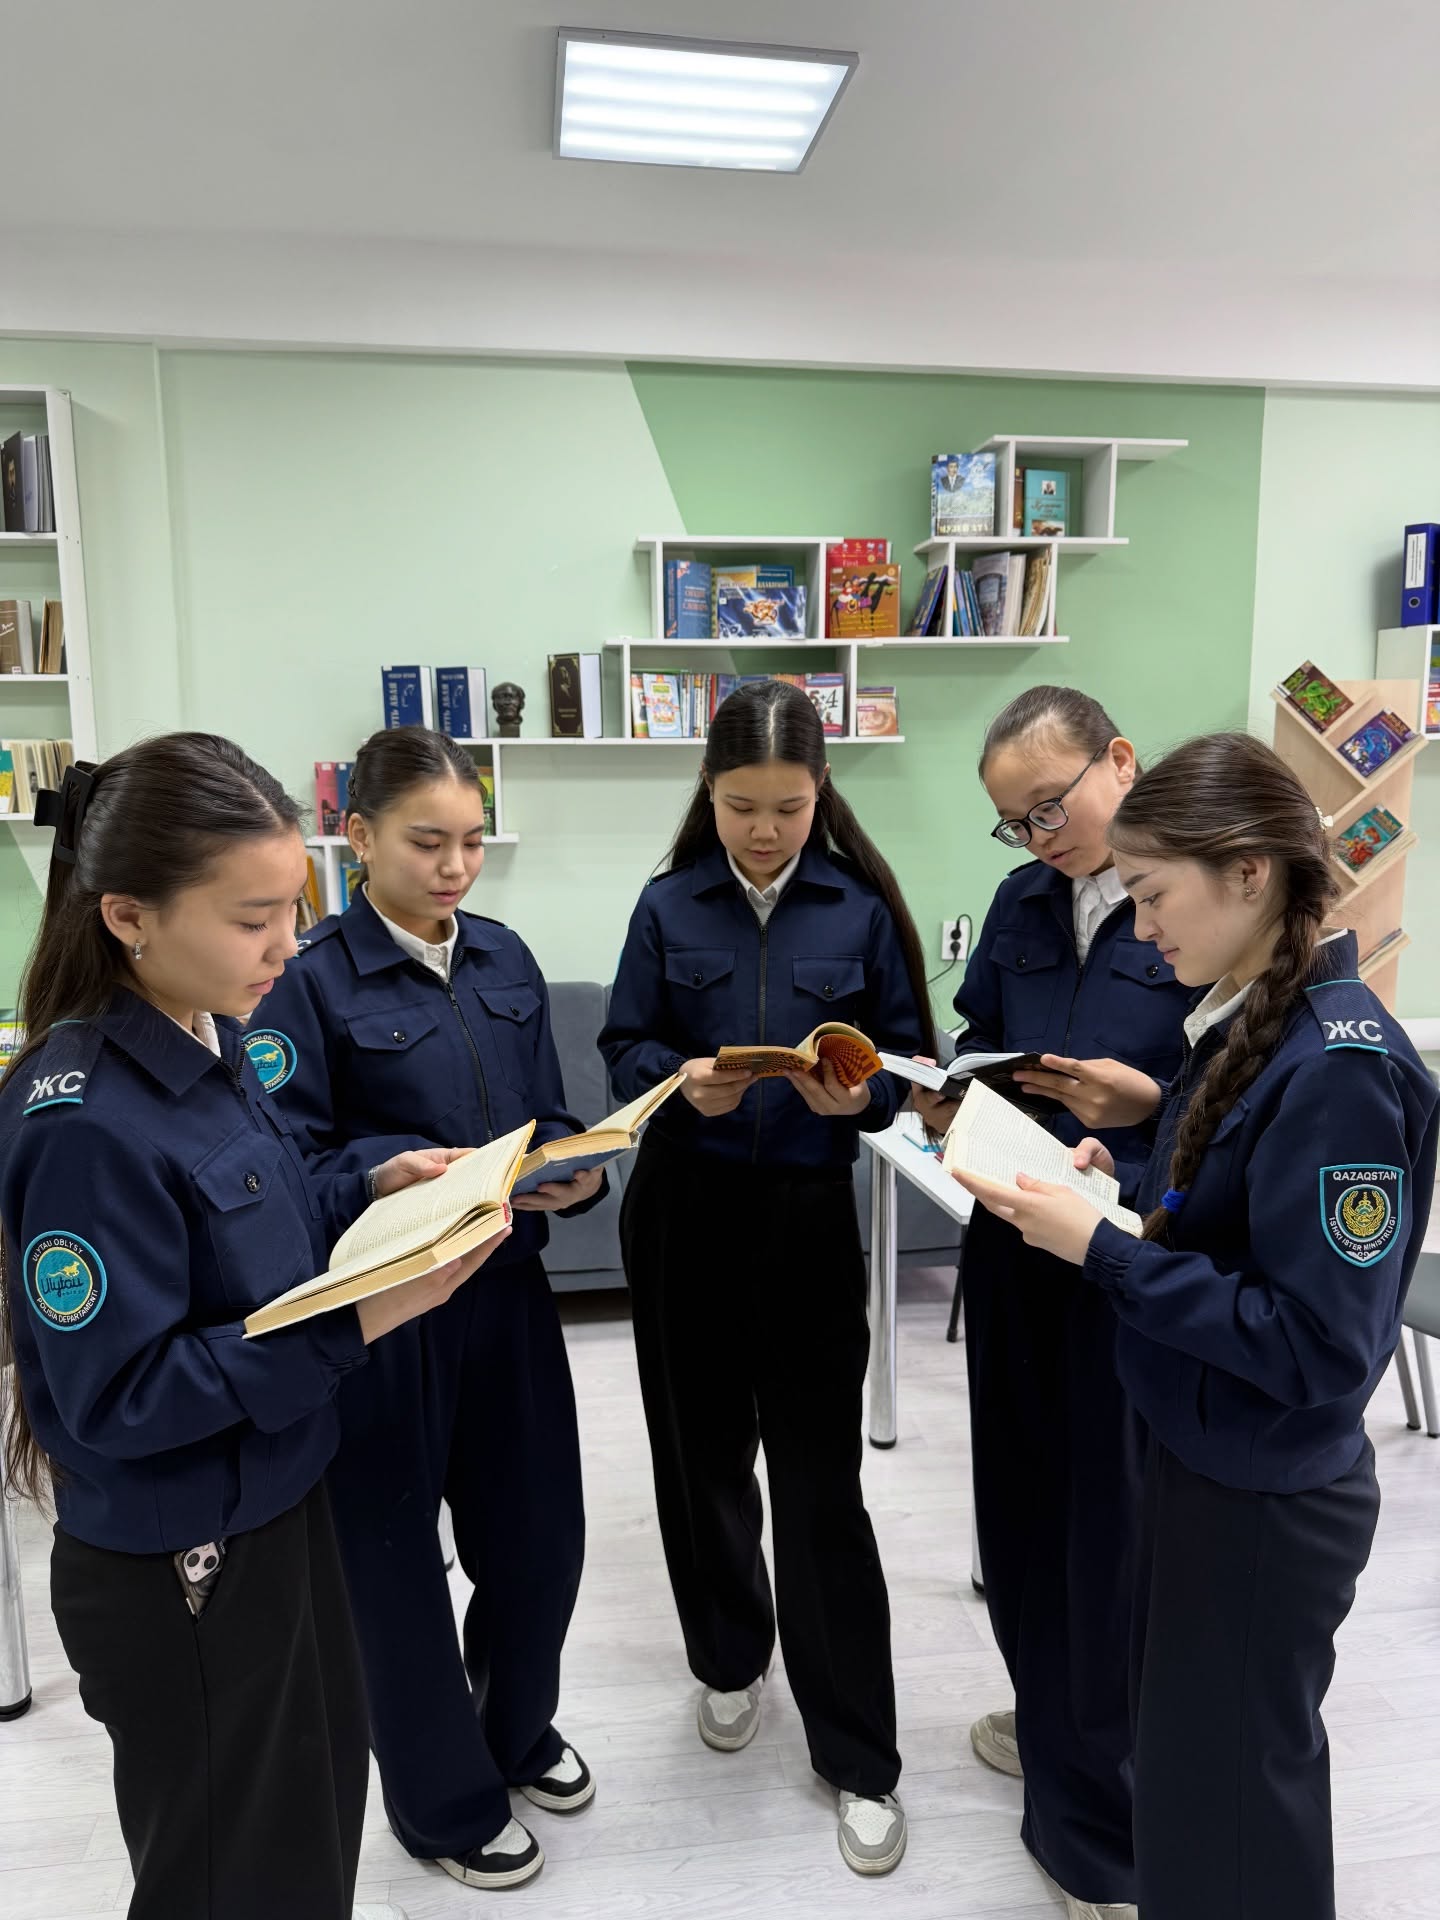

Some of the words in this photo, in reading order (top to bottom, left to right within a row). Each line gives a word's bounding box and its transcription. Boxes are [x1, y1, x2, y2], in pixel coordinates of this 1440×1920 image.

[1322, 1019, 1383, 1042] ЖС
[26, 1070, 86, 1104] ЖС
[1332, 1170, 1397, 1181] QAZAQSTAN
[1328, 1216, 1343, 1241] ISHKI
[1342, 1238, 1363, 1251] ISTER
[1363, 1216, 1397, 1251] MINISTRLIGI
[32, 1239, 52, 1262] ULYTAU
[53, 1238, 84, 1255] OBLYSY
[36, 1297, 58, 1321] POLISIA
[58, 1289, 99, 1323] DEPARTAMENTI
